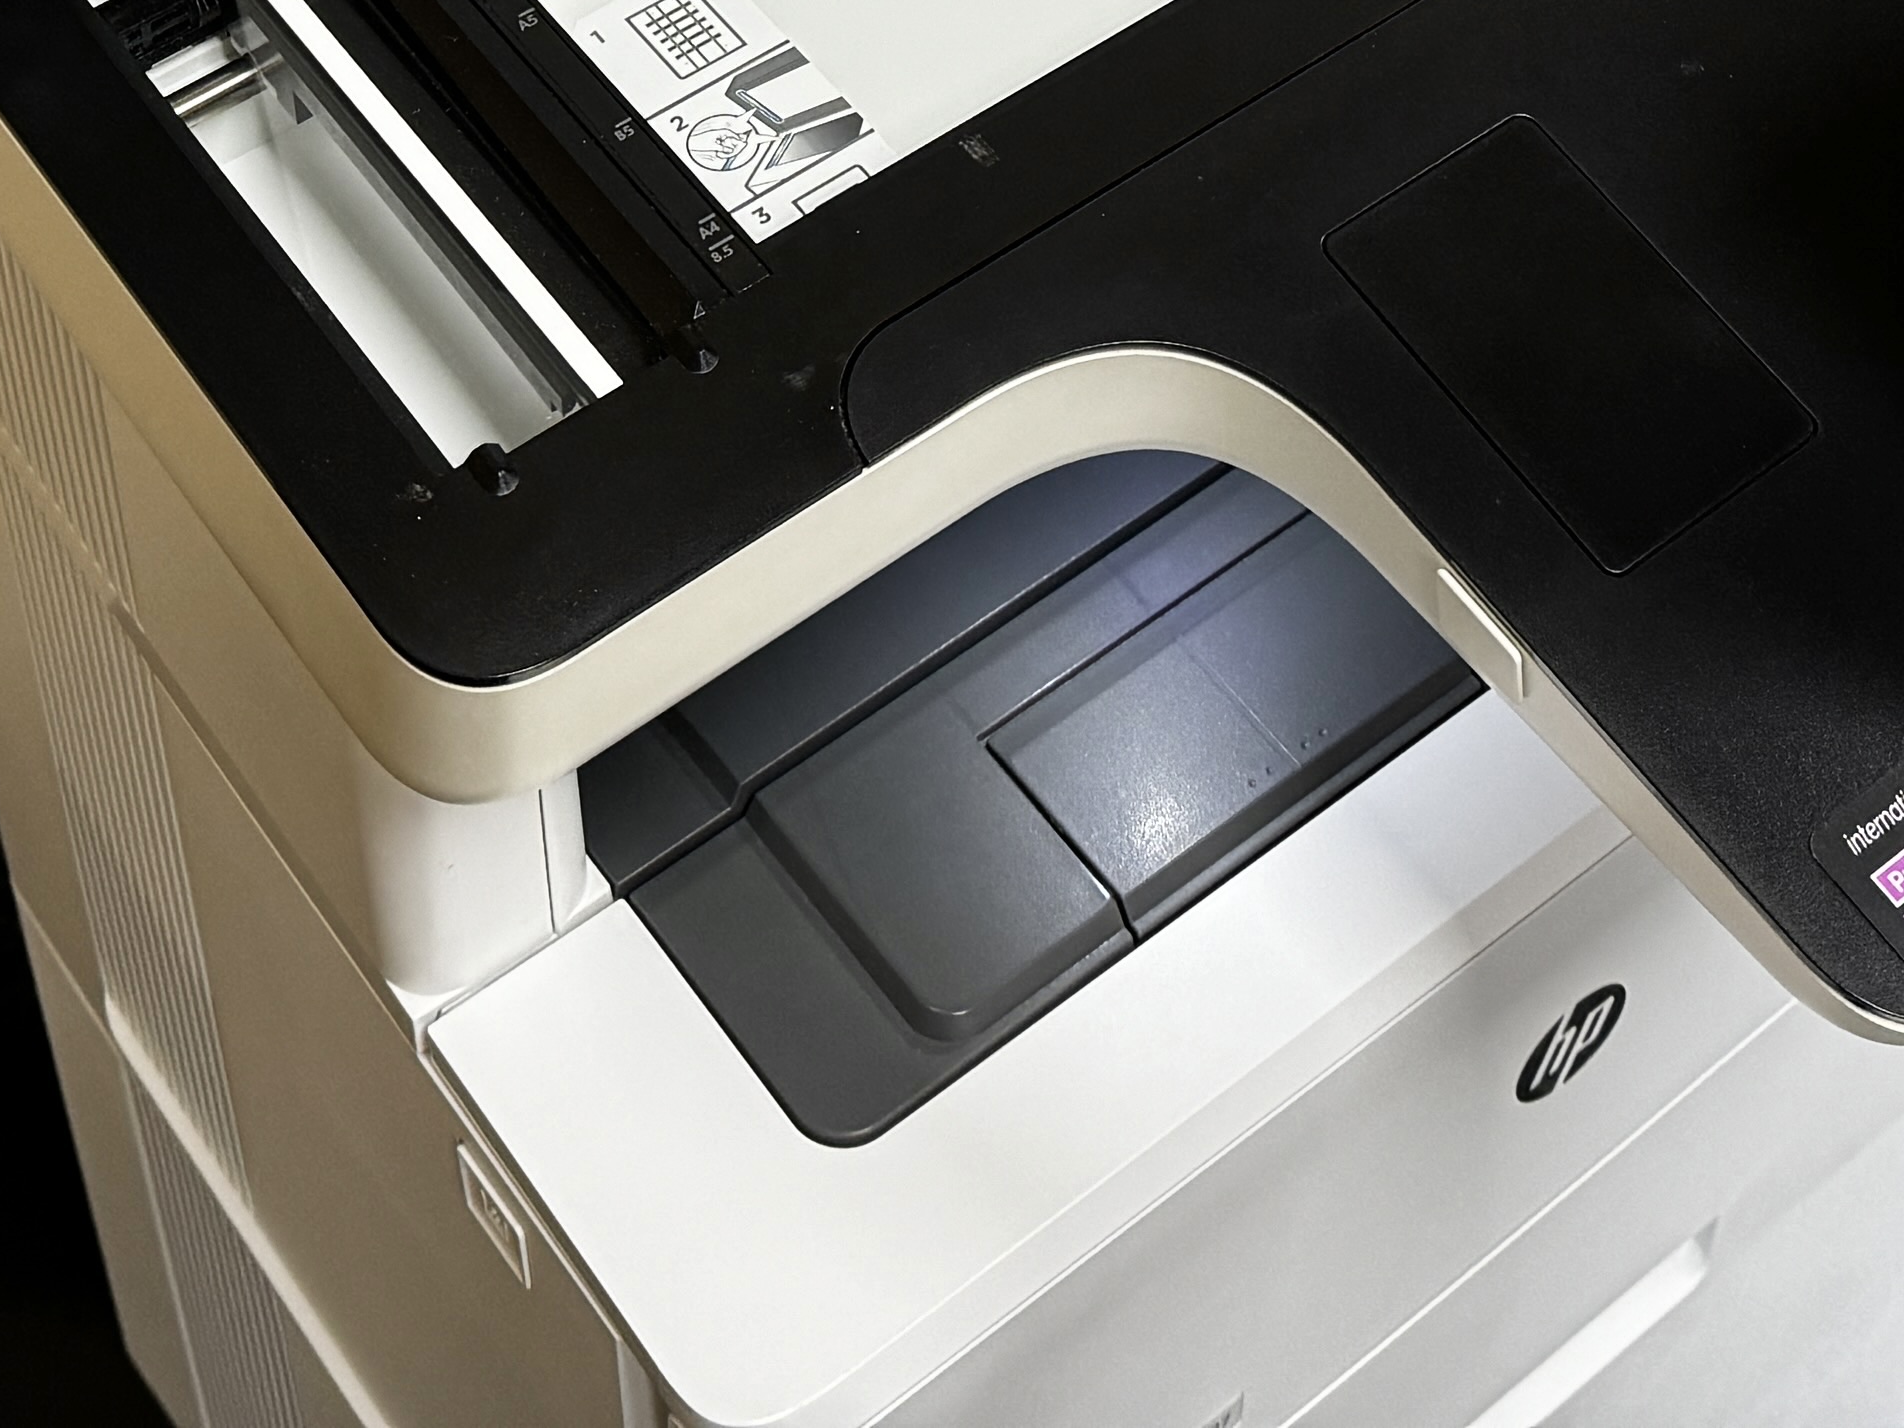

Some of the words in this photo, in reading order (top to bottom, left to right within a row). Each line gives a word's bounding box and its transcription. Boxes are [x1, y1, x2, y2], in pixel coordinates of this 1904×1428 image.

[518, 14, 538, 31] A5
[589, 30, 605, 43] 1
[670, 115, 689, 132] 2
[614, 125, 635, 141] B5
[751, 206, 771, 224] 3
[698, 220, 720, 240] A4
[710, 244, 734, 263] 8.5
[1527, 993, 1616, 1094] hp
